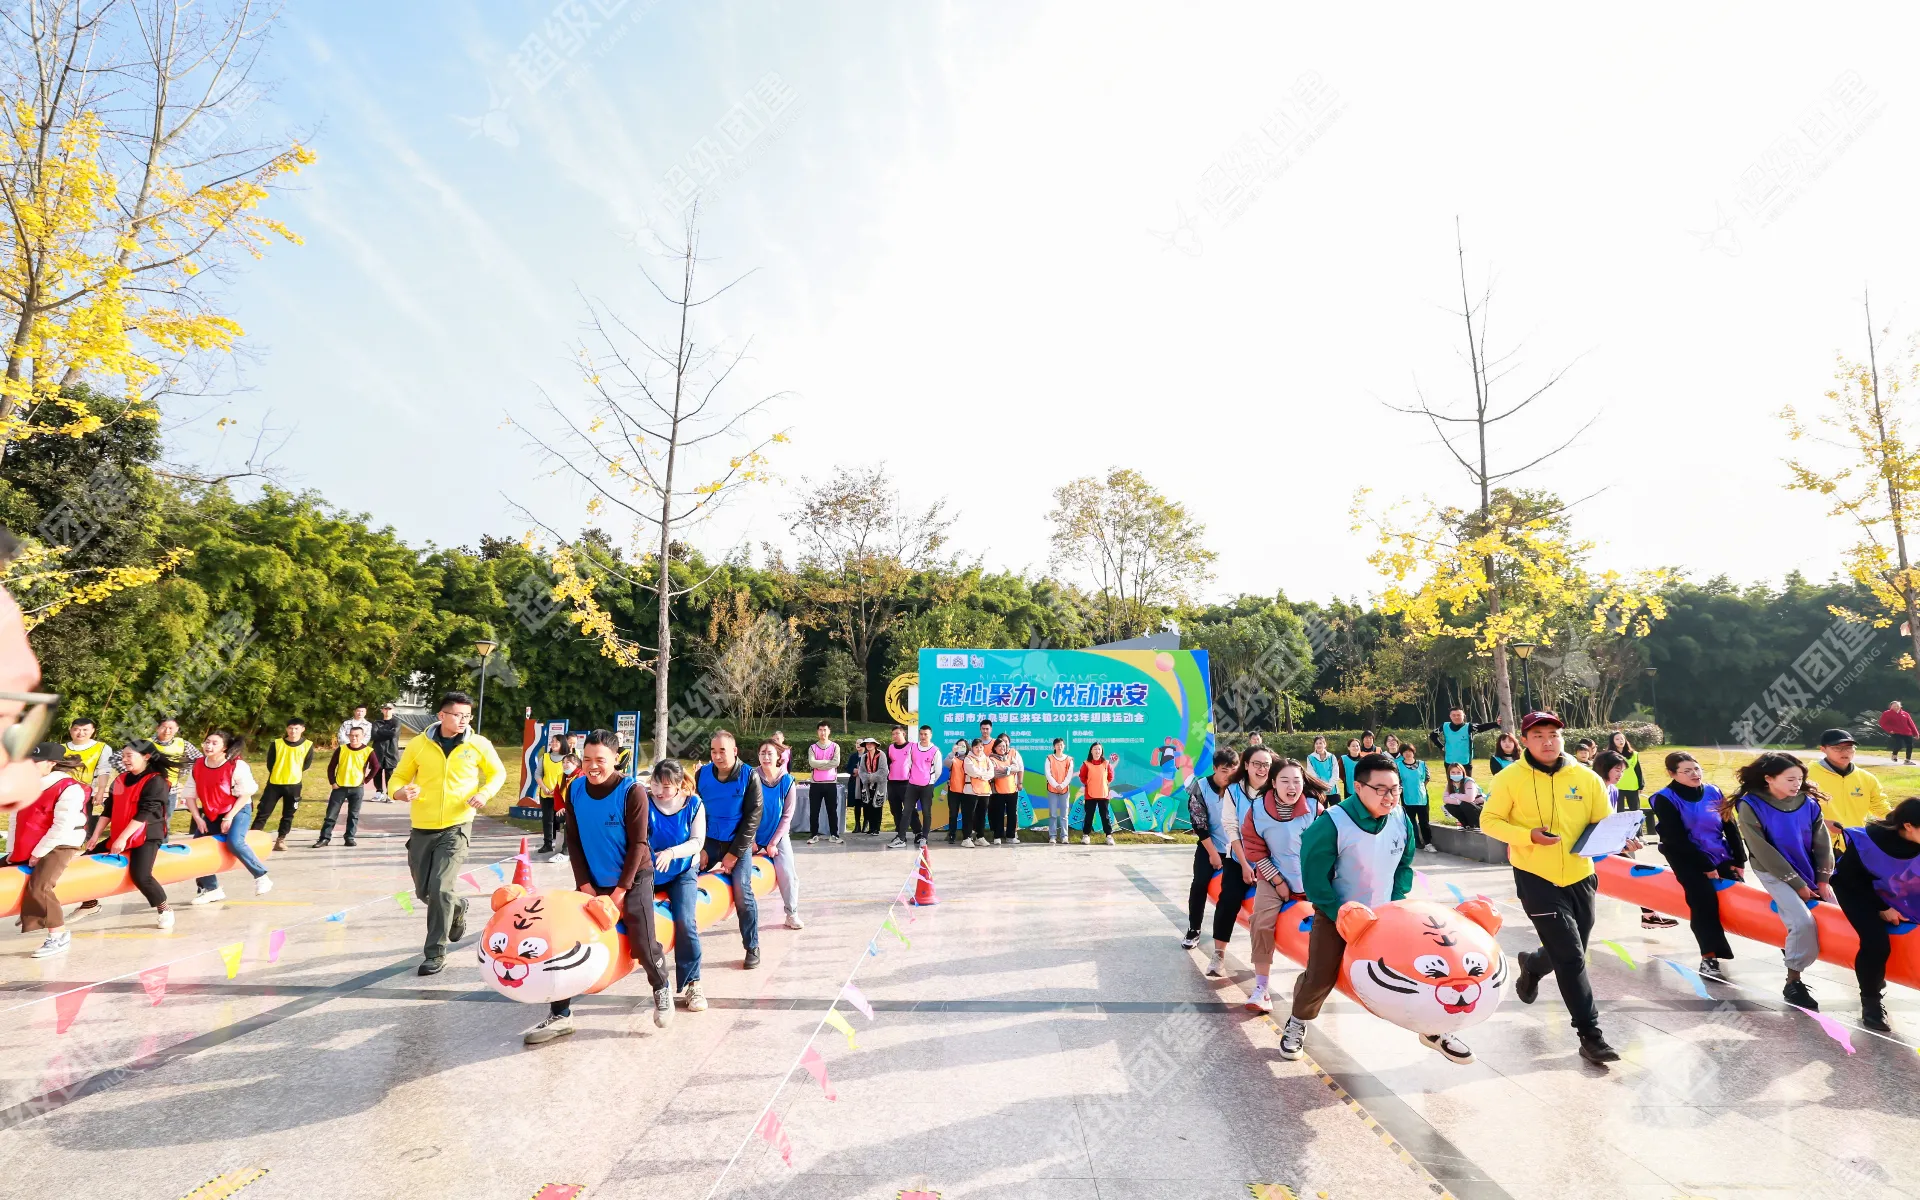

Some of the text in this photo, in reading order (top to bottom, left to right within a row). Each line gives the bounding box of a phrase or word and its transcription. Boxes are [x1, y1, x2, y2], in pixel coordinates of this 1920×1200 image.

[938, 682, 1149, 707] 凝心聚力·悦动洪安
